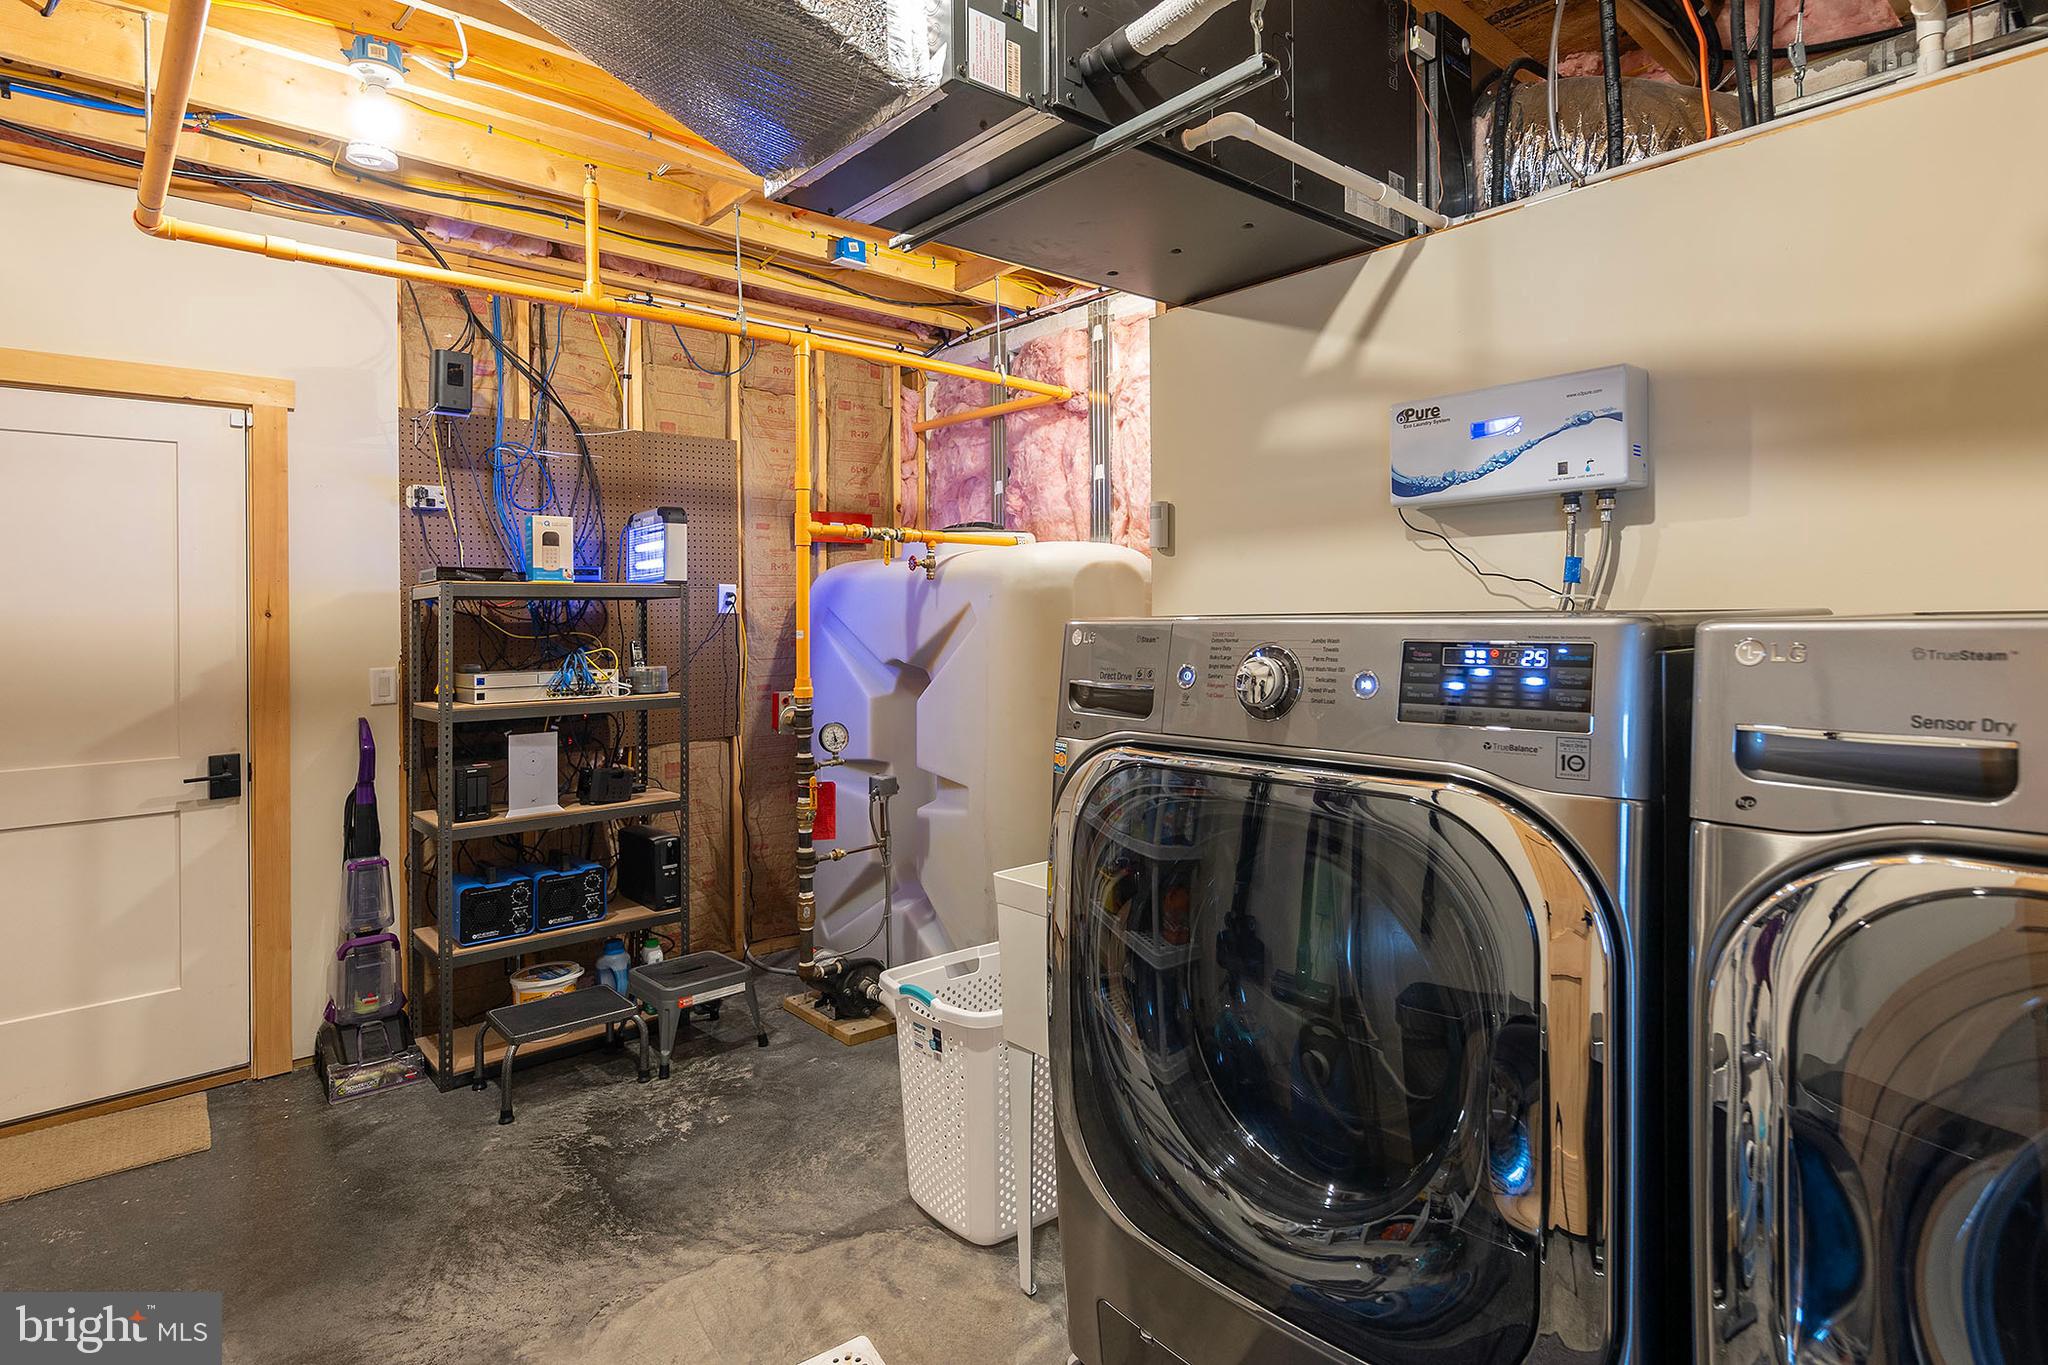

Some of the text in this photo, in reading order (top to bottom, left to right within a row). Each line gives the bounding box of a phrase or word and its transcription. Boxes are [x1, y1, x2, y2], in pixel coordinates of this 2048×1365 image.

[773, 366, 792, 376] R-19
[850, 430, 869, 439] R-19
[1521, 650, 1547, 667] 25
[1927, 649, 2008, 661] TrueSteam
[1100, 671, 1133, 681] Direct Drive
[1910, 714, 2018, 737] Sensor Dry
[1493, 742, 1538, 754] TrueBalance
[1561, 754, 1586, 772] 10
